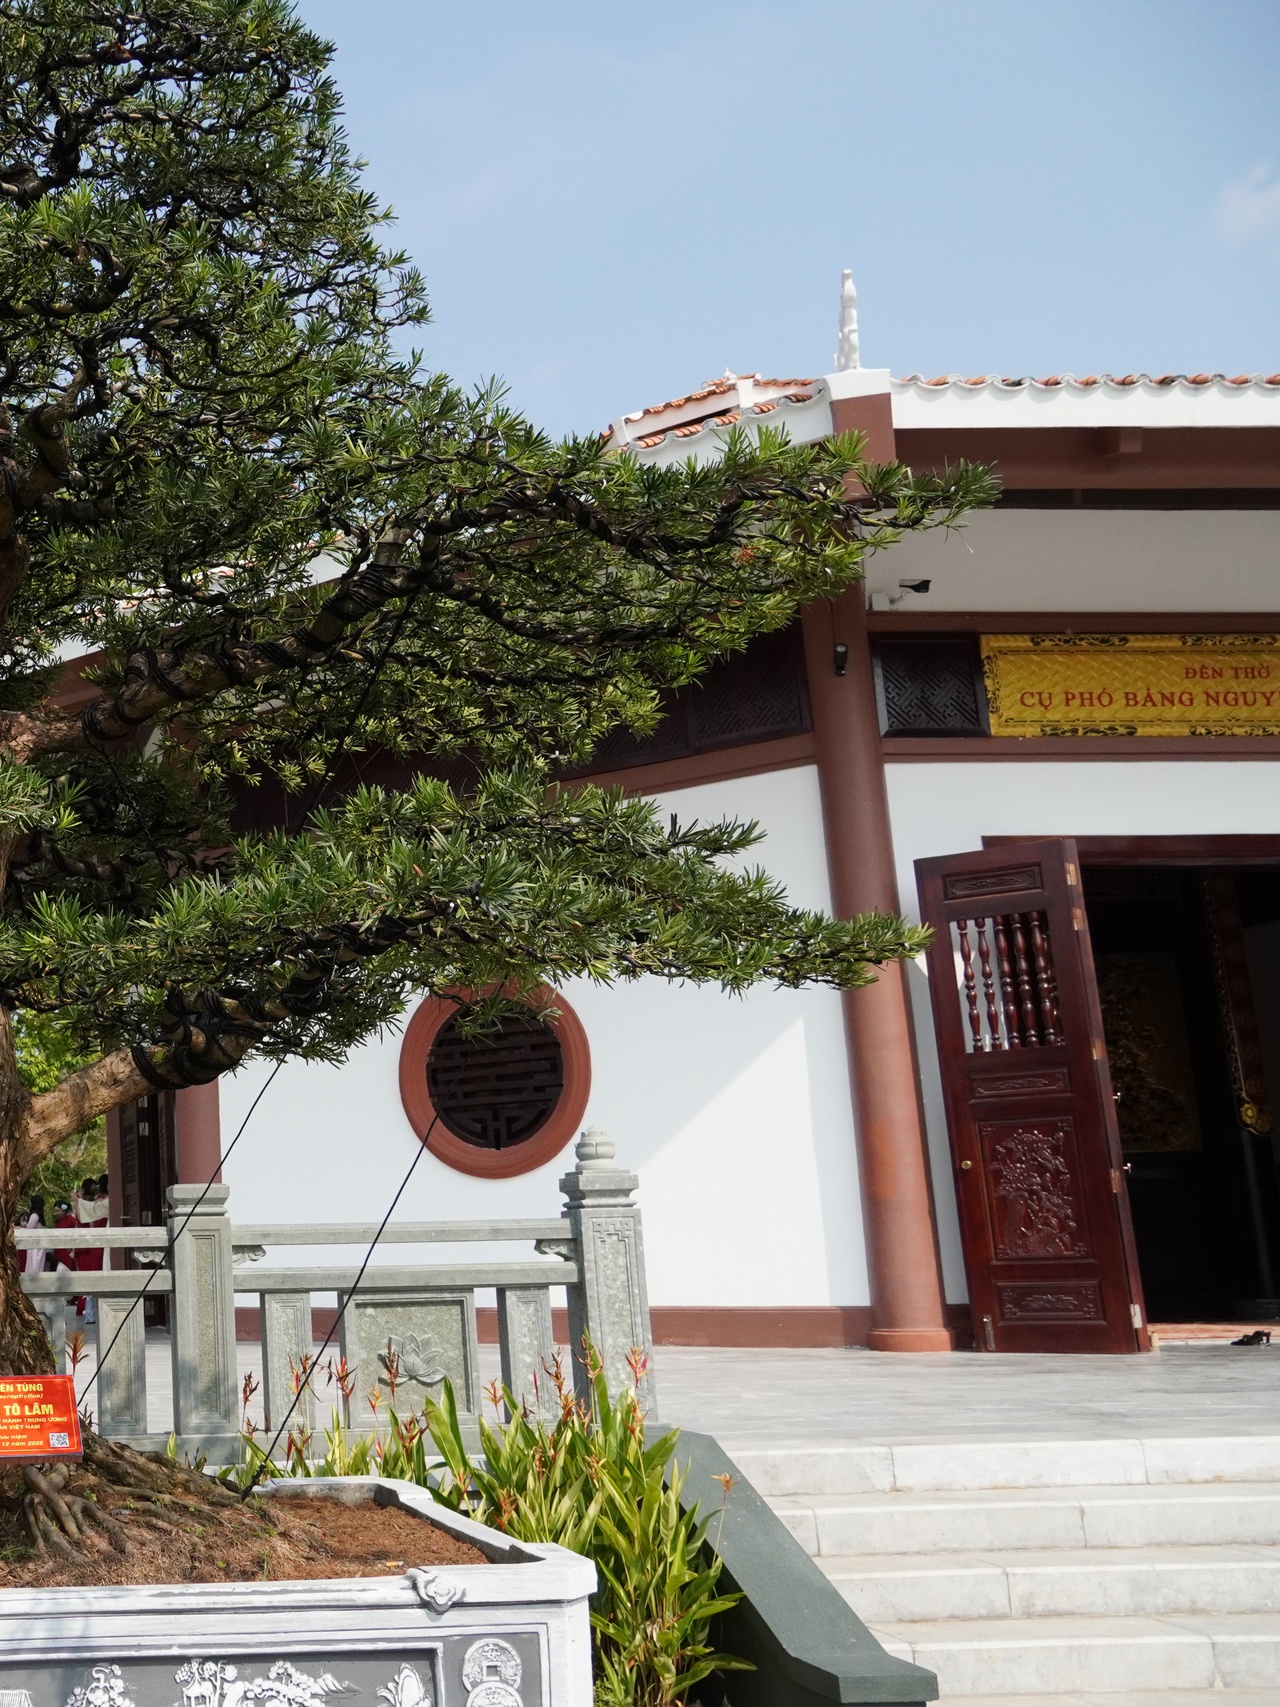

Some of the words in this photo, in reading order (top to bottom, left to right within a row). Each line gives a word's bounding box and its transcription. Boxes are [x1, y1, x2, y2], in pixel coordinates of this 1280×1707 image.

[1019, 691, 1053, 710] CỤ
[1063, 687, 1113, 707] PHÓ
[1123, 687, 1195, 707] BẢNG
[1203, 691, 1280, 707] NGUY
[16, 1382, 43, 1392] TÙNG
[3, 1403, 21, 1416] TÔ
[24, 1402, 54, 1415] LÂM
